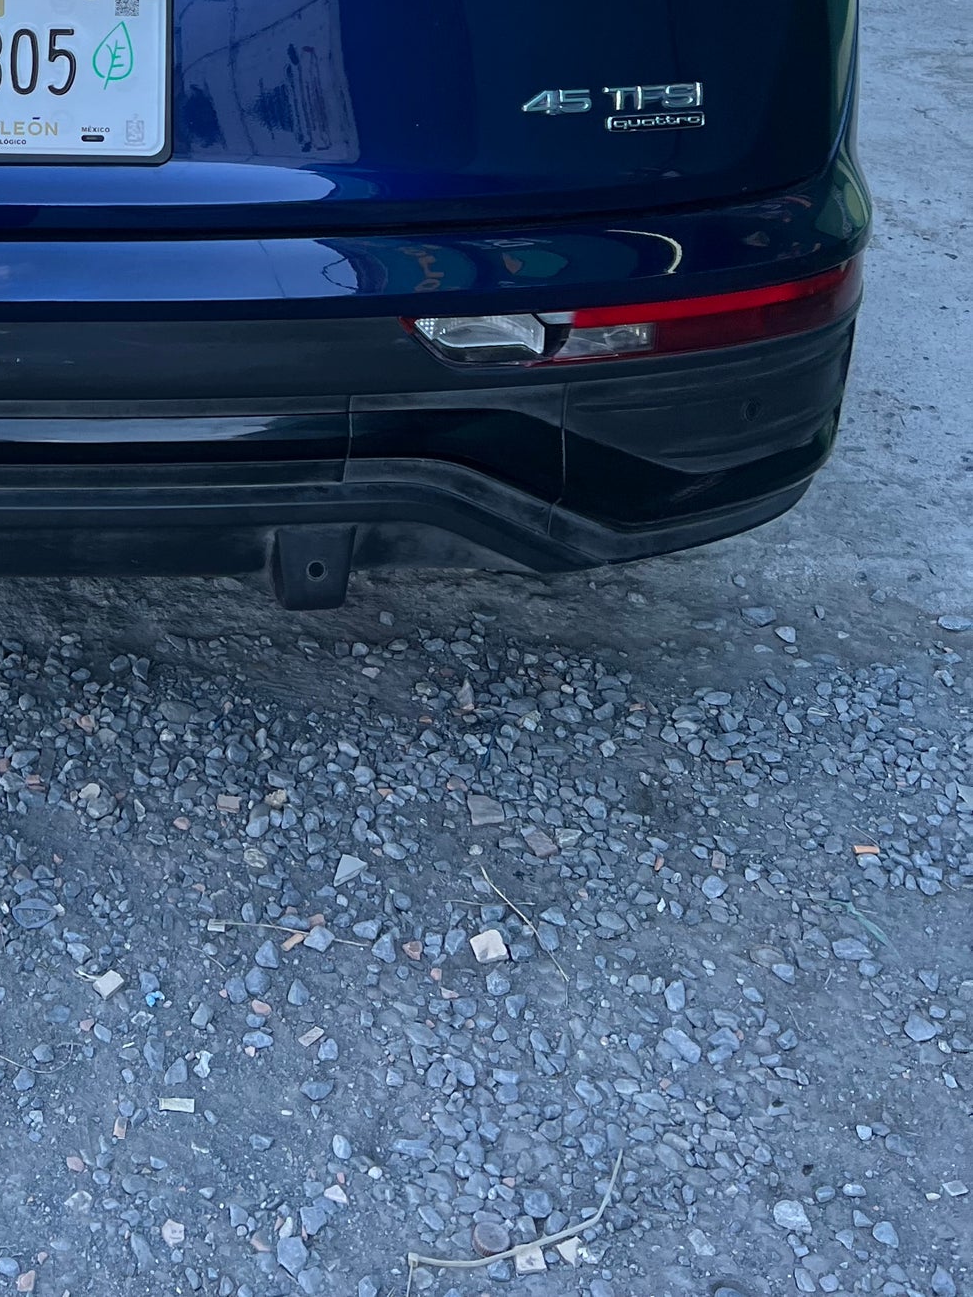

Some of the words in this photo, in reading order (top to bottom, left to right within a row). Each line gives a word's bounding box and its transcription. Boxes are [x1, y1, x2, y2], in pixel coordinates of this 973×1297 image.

[522, 89, 592, 116] 45
[601, 81, 704, 111] TFSI
[612, 114, 702, 130] quattro
